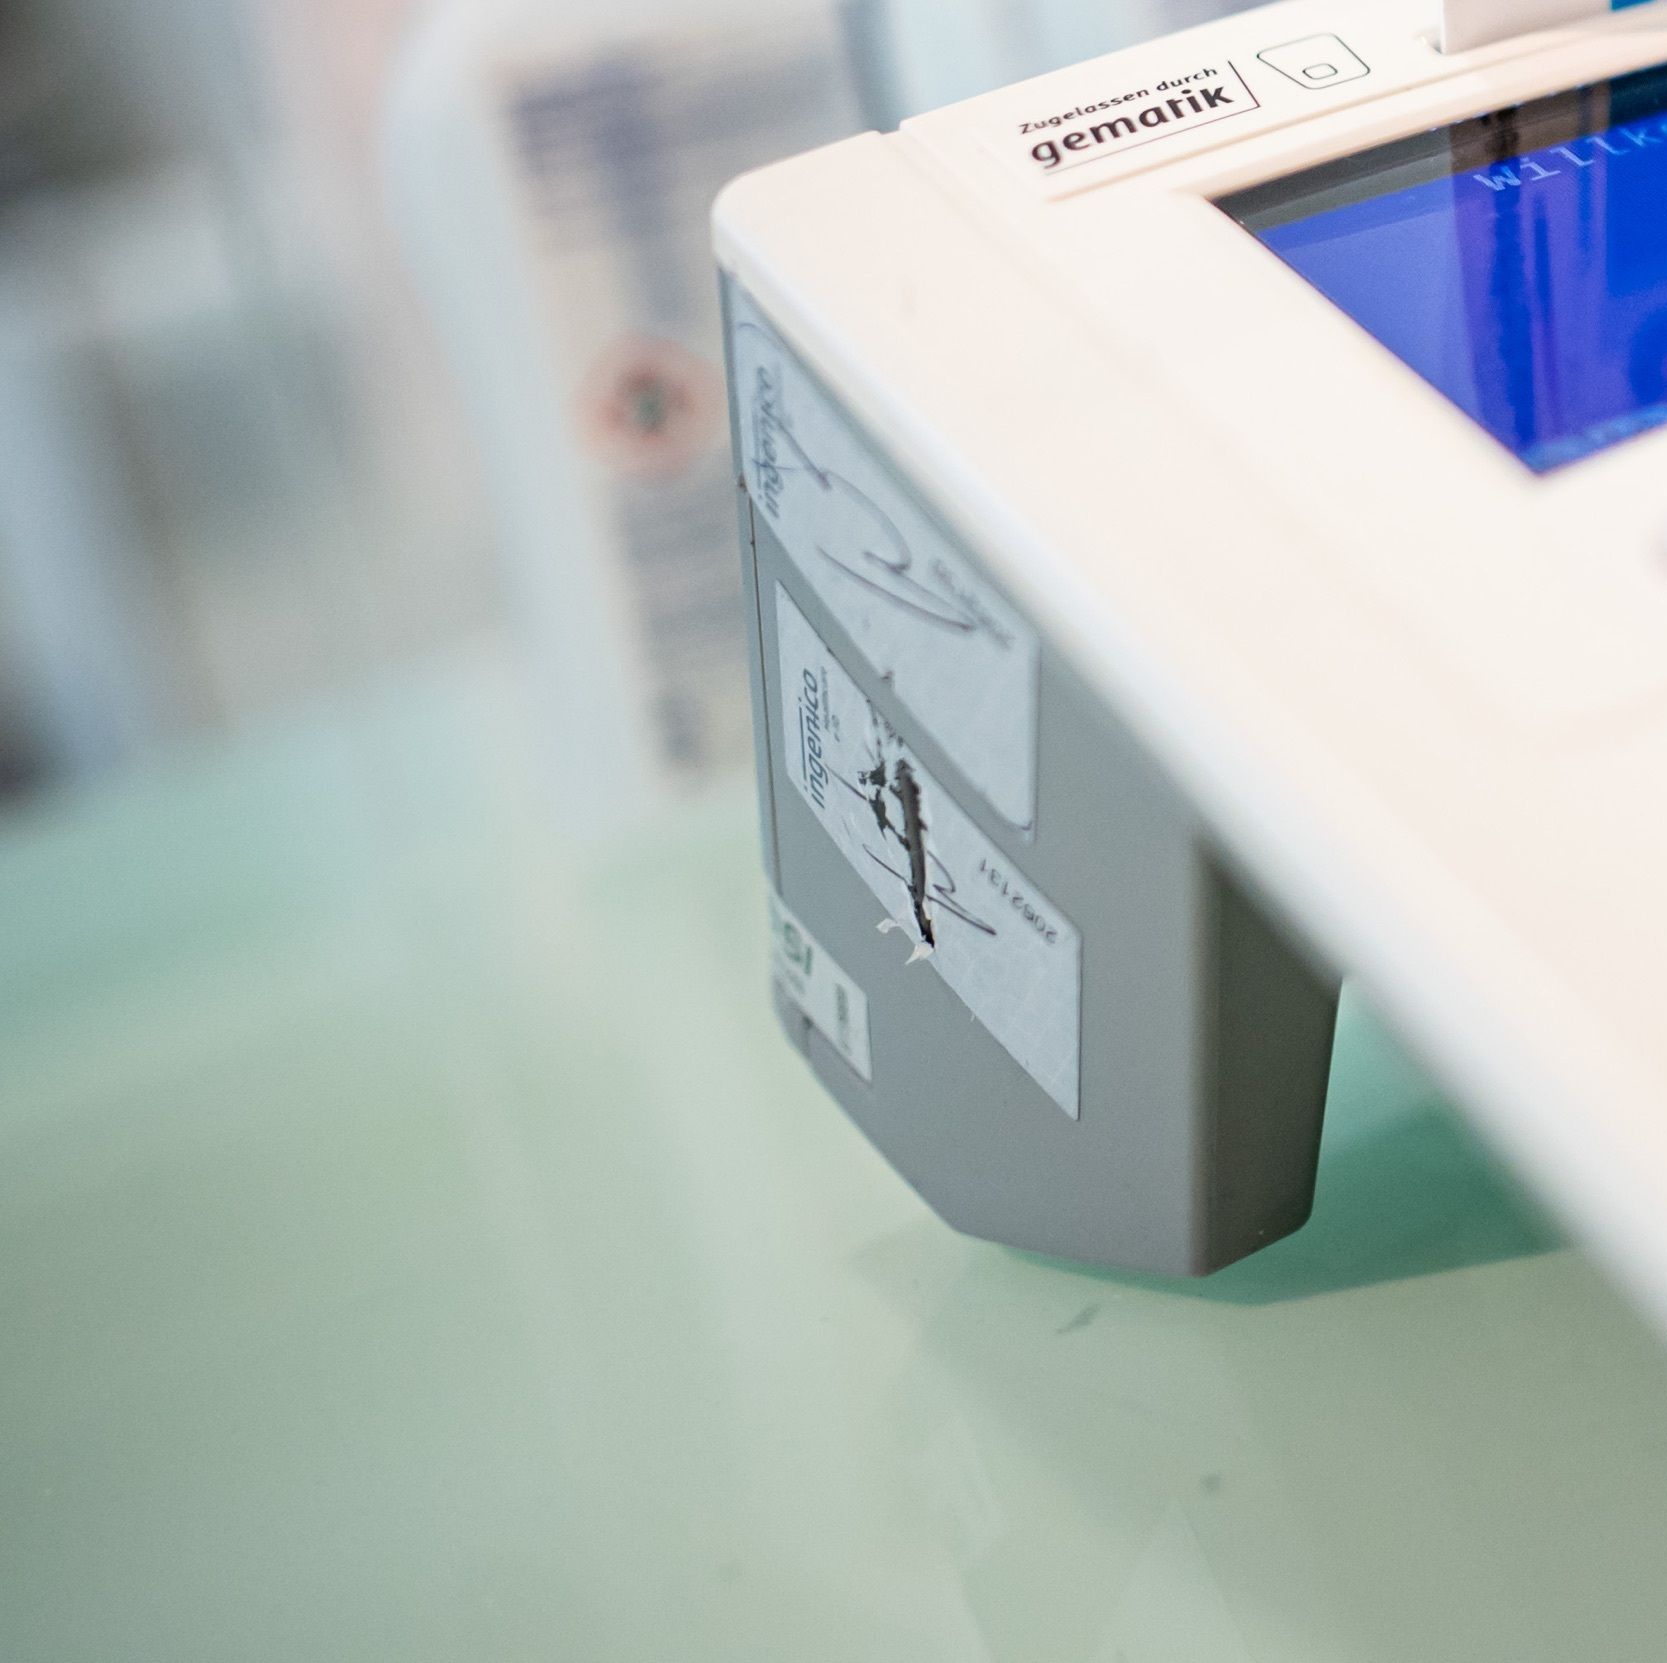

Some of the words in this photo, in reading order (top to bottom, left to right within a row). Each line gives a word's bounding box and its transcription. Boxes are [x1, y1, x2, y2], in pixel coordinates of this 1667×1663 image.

[1018, 87, 1150, 135] Zugelassen
[1156, 67, 1218, 92] durch
[1031, 86, 1235, 169] gematik
[798, 667, 829, 810] ingenico
